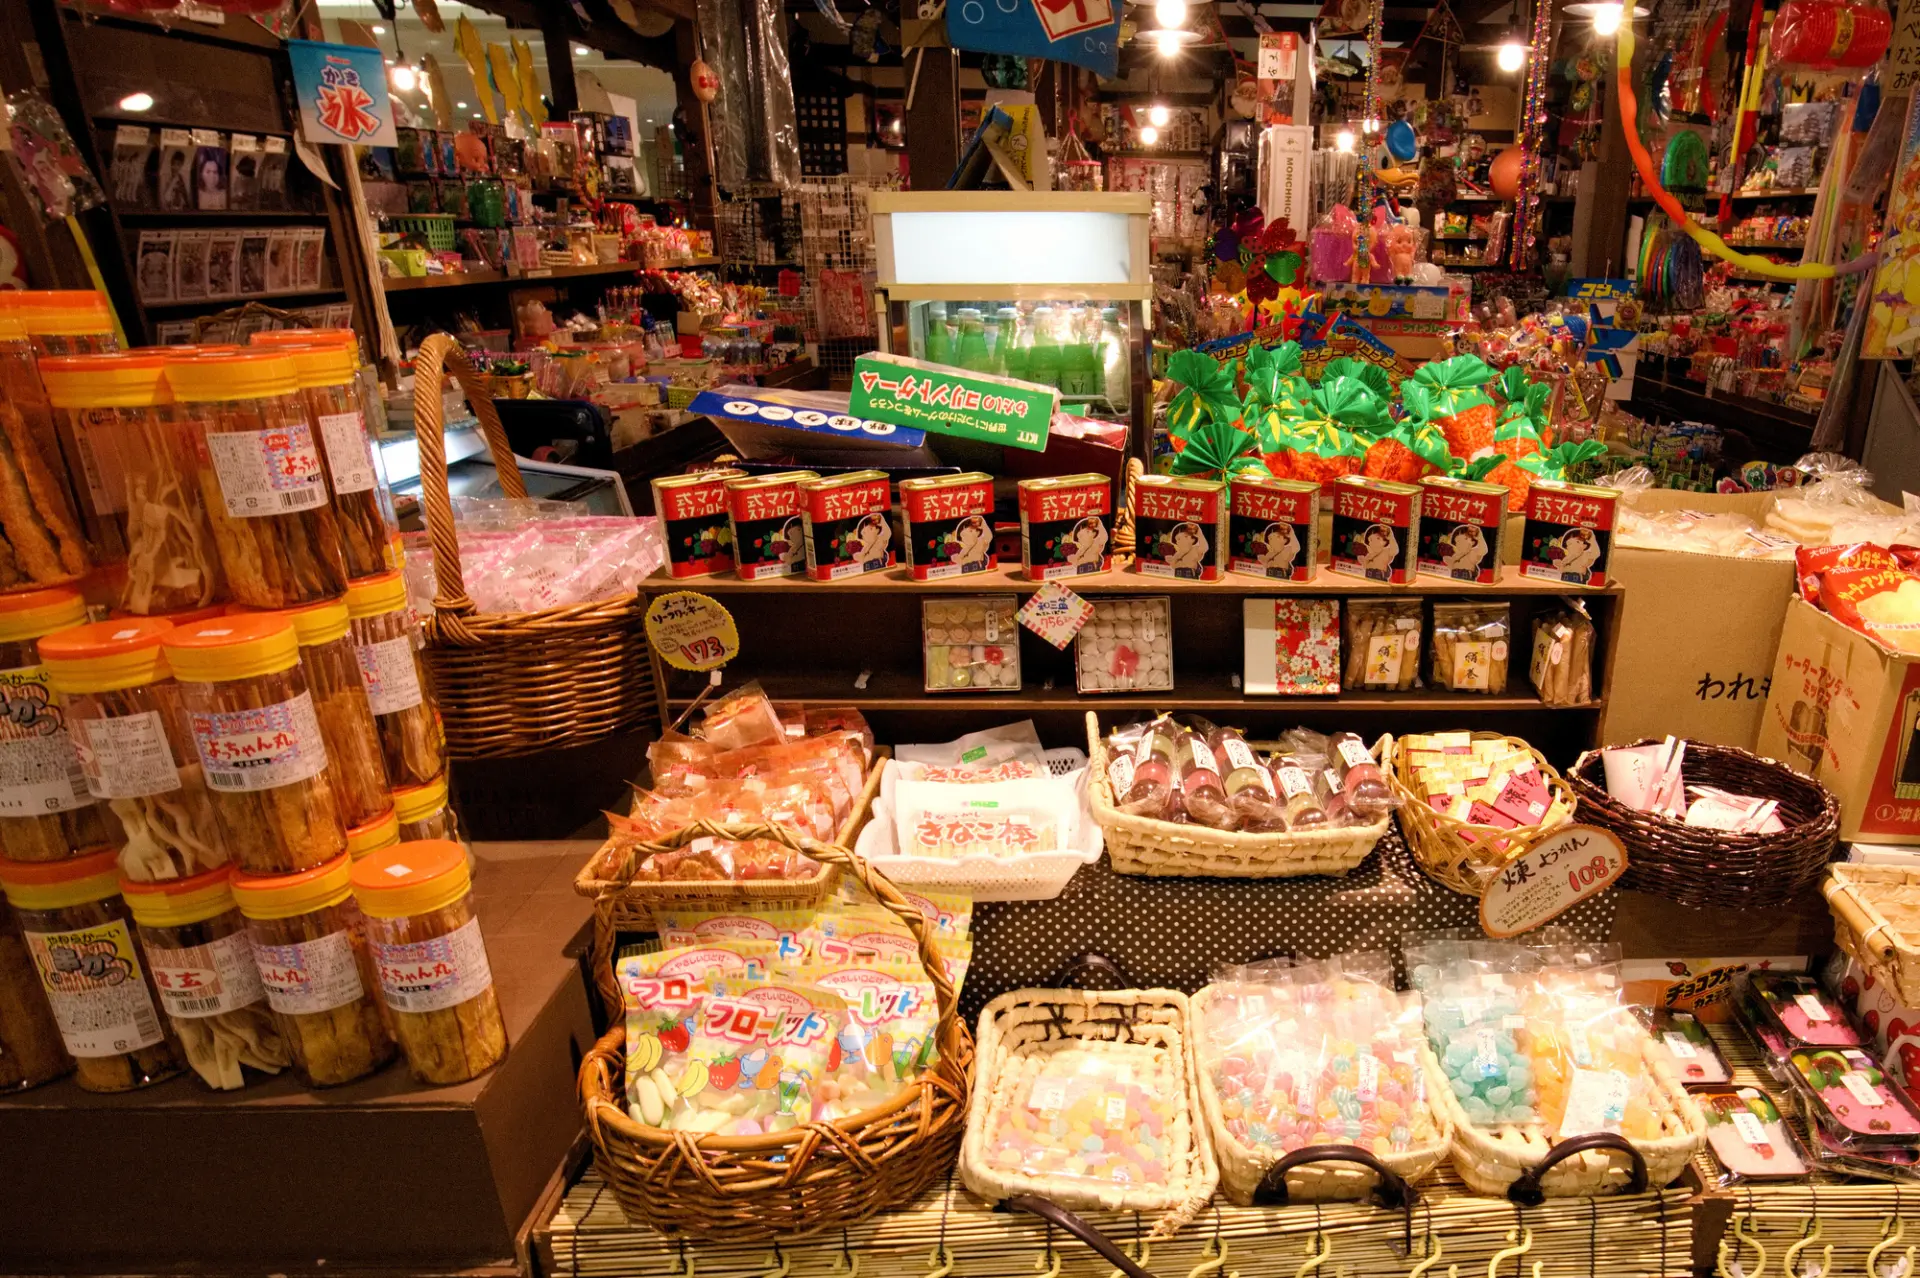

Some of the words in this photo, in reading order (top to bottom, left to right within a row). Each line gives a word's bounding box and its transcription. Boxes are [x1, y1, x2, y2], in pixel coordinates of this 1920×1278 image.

[321, 66, 359, 88] かき
[317, 86, 381, 139] 氷
[1284, 157, 1294, 222] MONCHHICH
[858, 370, 1029, 417] わたしのコリントゲーム
[869, 398, 1008, 434] 世界に1つだけのゲームをつくろう
[1016, 428, 1039, 444] KIT
[680, 636, 726, 666] 173
[208, 731, 293, 760] よっちゃん丸
[917, 818, 1038, 846] きなこ棒
[1568, 855, 1610, 892] 108
[50, 947, 126, 986] 串かつ
[705, 1004, 822, 1042] フローレット
